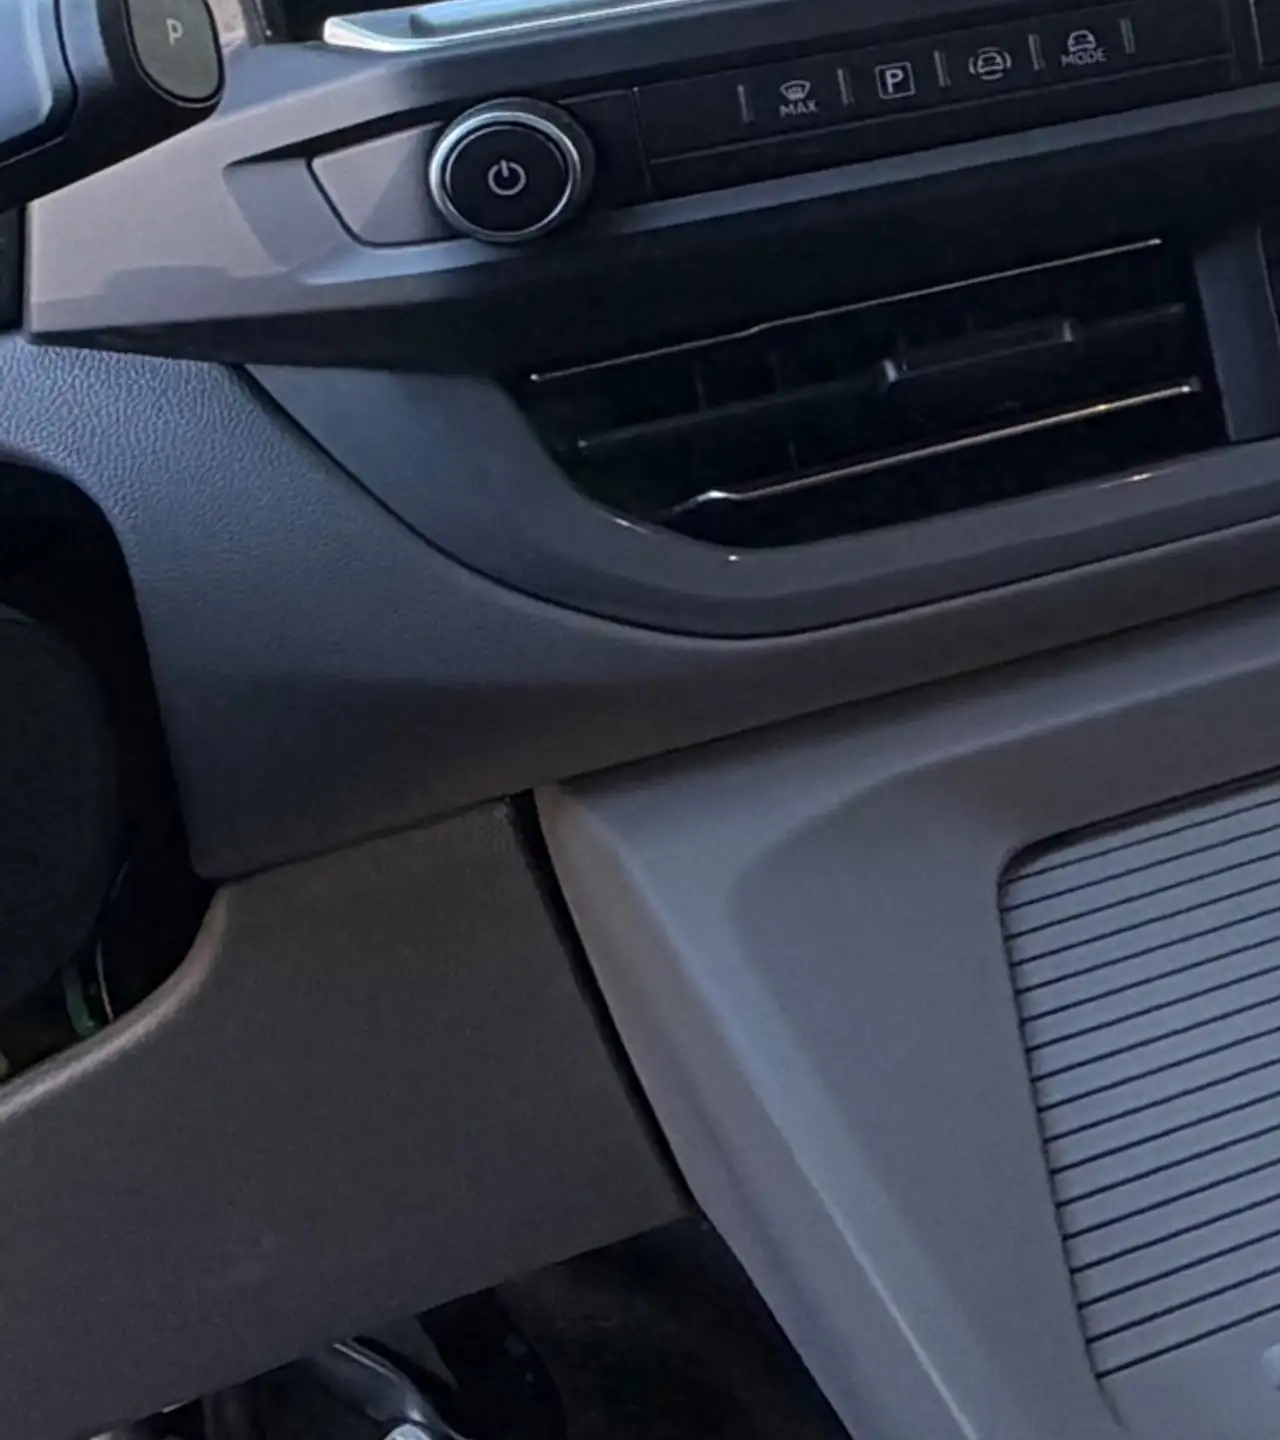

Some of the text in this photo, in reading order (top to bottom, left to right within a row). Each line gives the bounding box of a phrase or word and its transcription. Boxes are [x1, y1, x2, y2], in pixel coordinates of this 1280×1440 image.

[166, 18, 183, 45] P
[1061, 48, 1107, 66] MODE
[885, 69, 905, 94] P
[779, 101, 818, 117] MAX
